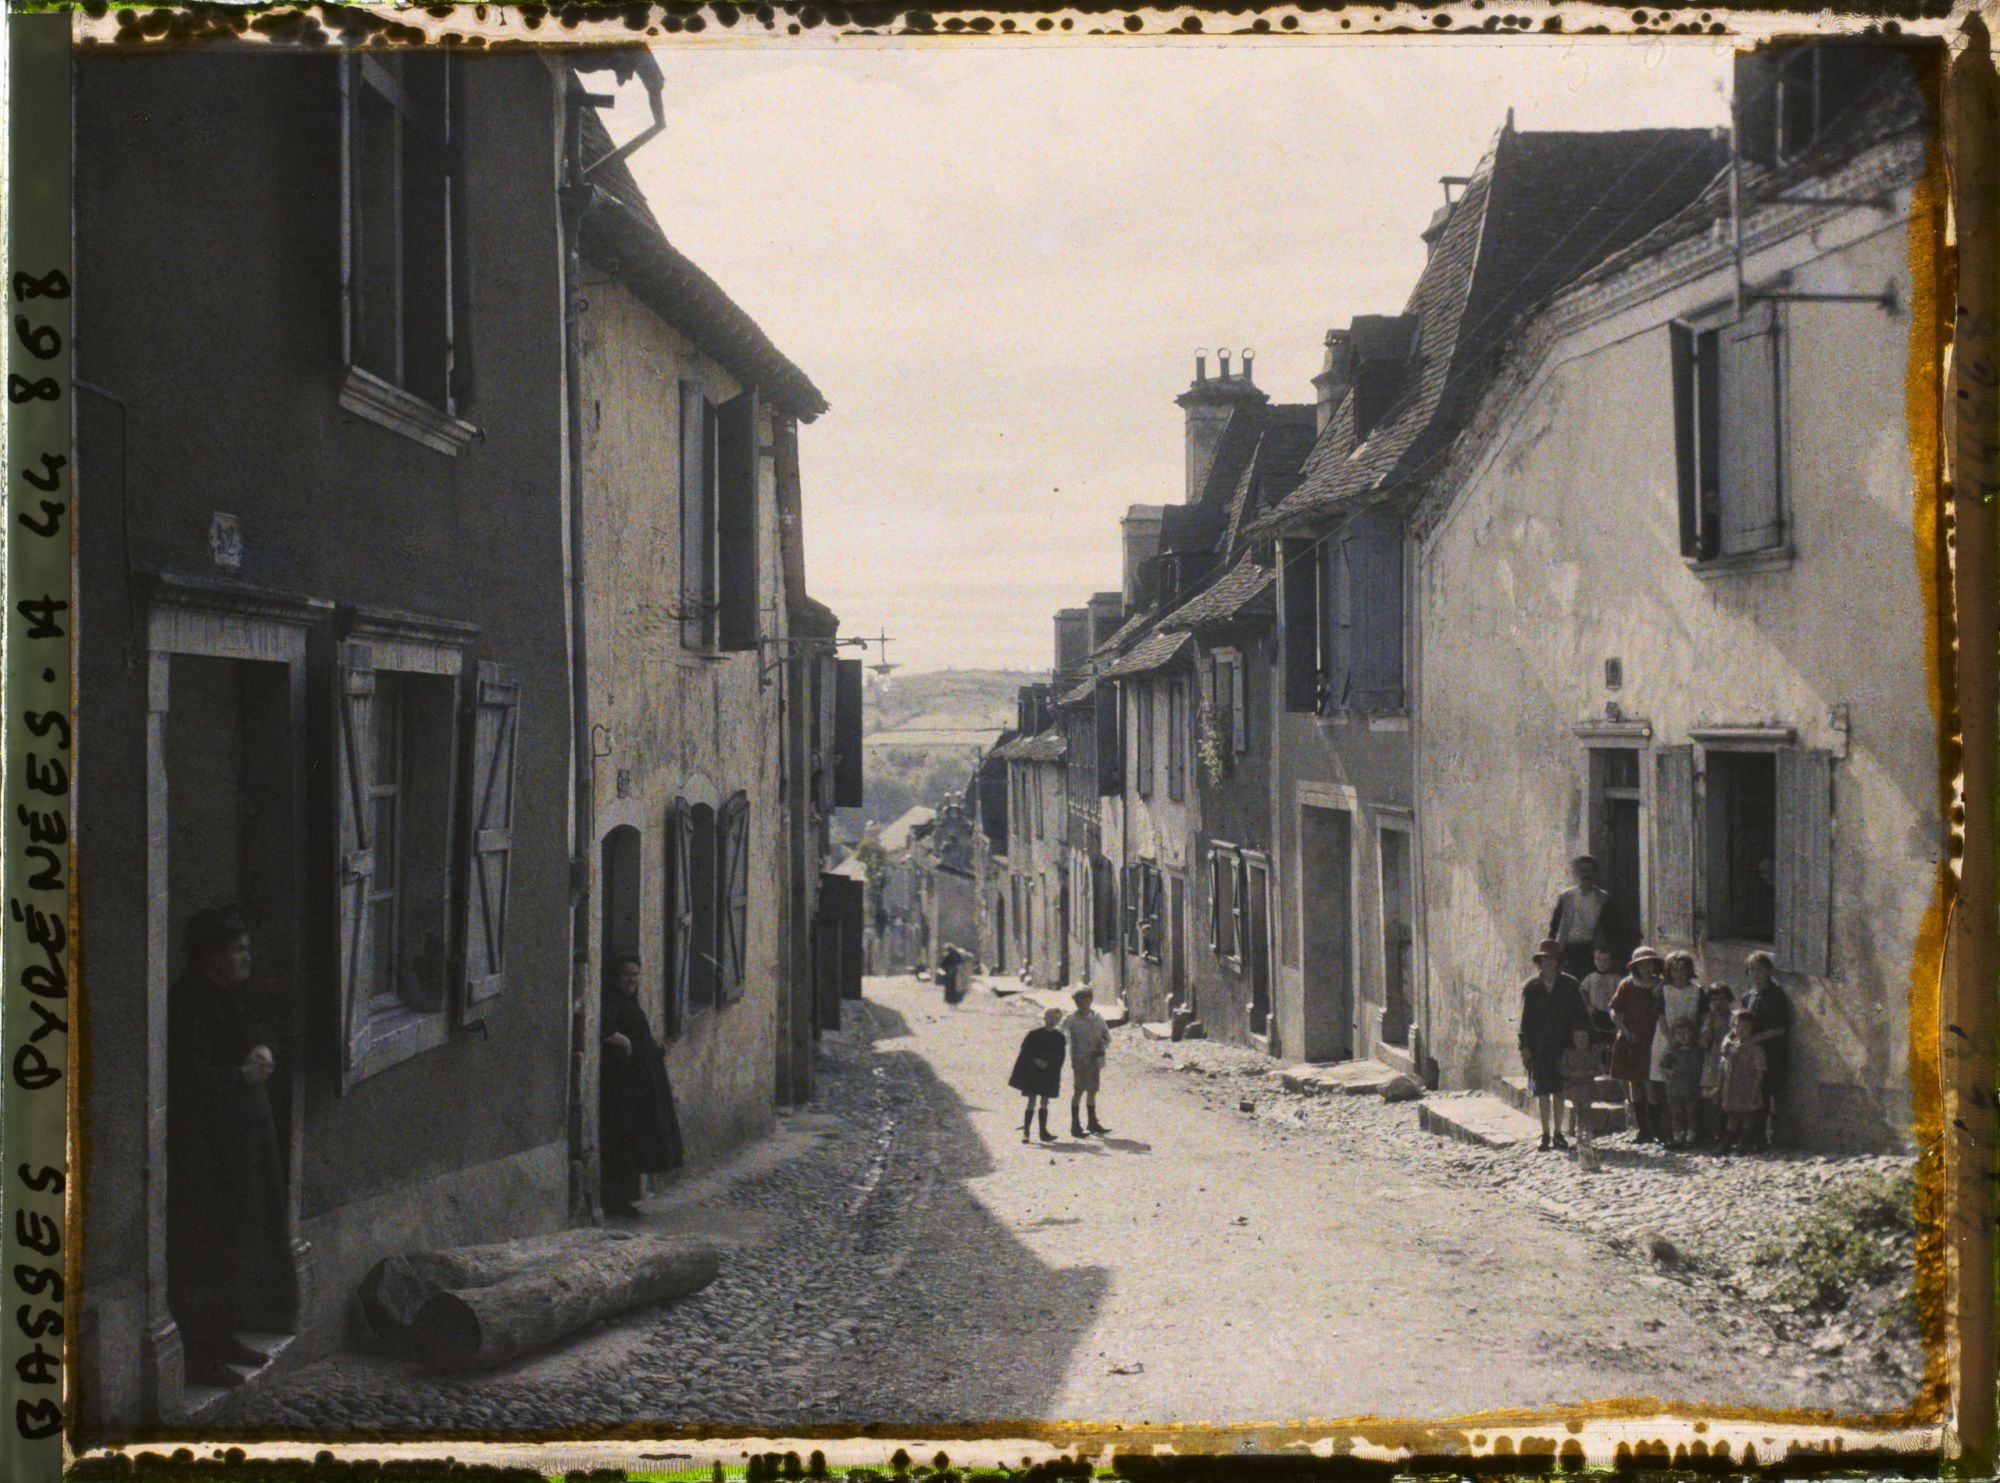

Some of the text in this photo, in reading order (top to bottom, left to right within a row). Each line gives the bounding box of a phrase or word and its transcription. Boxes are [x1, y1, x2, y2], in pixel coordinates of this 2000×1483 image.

[8, 268, 71, 405] 868
[17, 452, 67, 540] 44
[16, 594, 69, 640] A
[14, 1163, 64, 1440] BASSES
